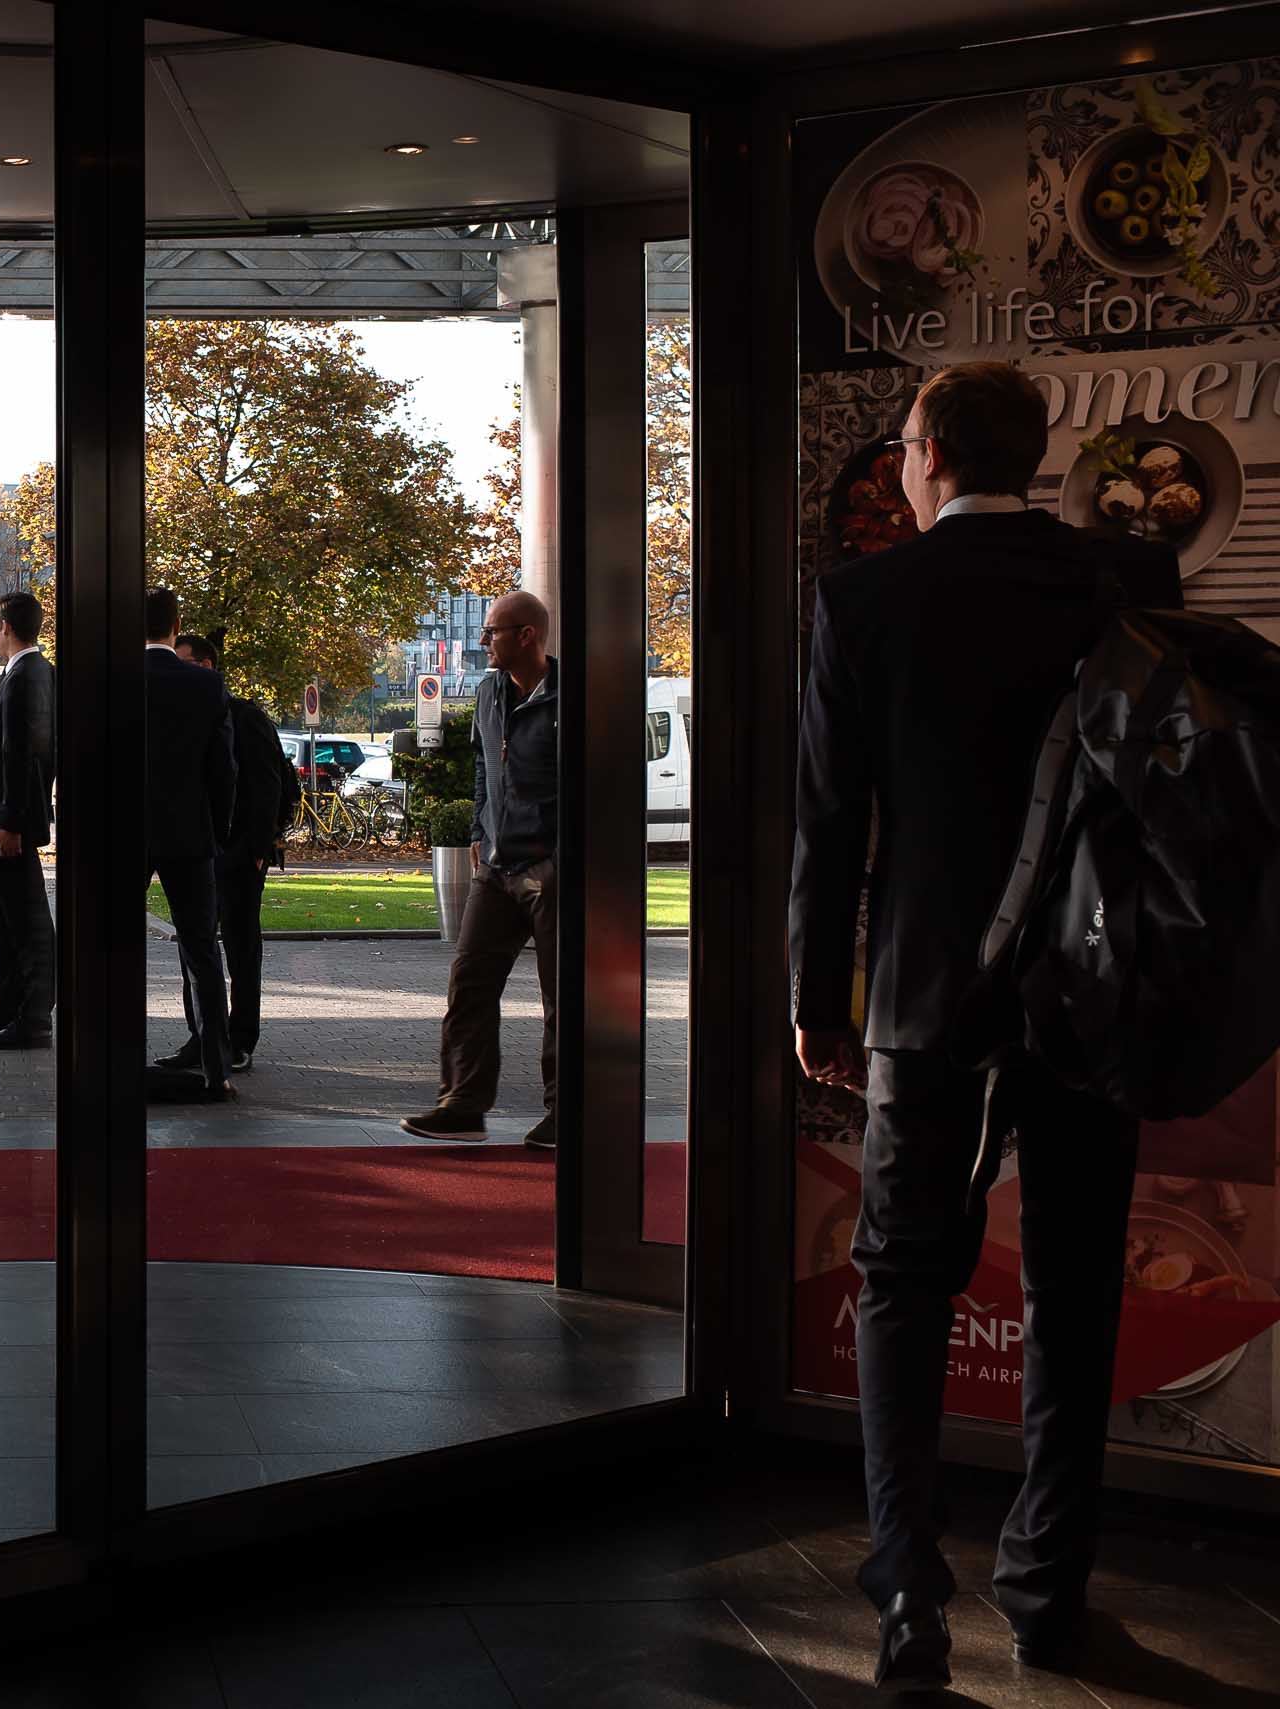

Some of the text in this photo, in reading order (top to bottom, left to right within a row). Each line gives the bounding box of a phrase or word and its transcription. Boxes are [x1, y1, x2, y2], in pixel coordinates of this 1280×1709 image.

[844, 281, 1165, 353] Live life for
[1029, 357, 1280, 427] omen
[978, 1366, 1023, 1384] AIRP
